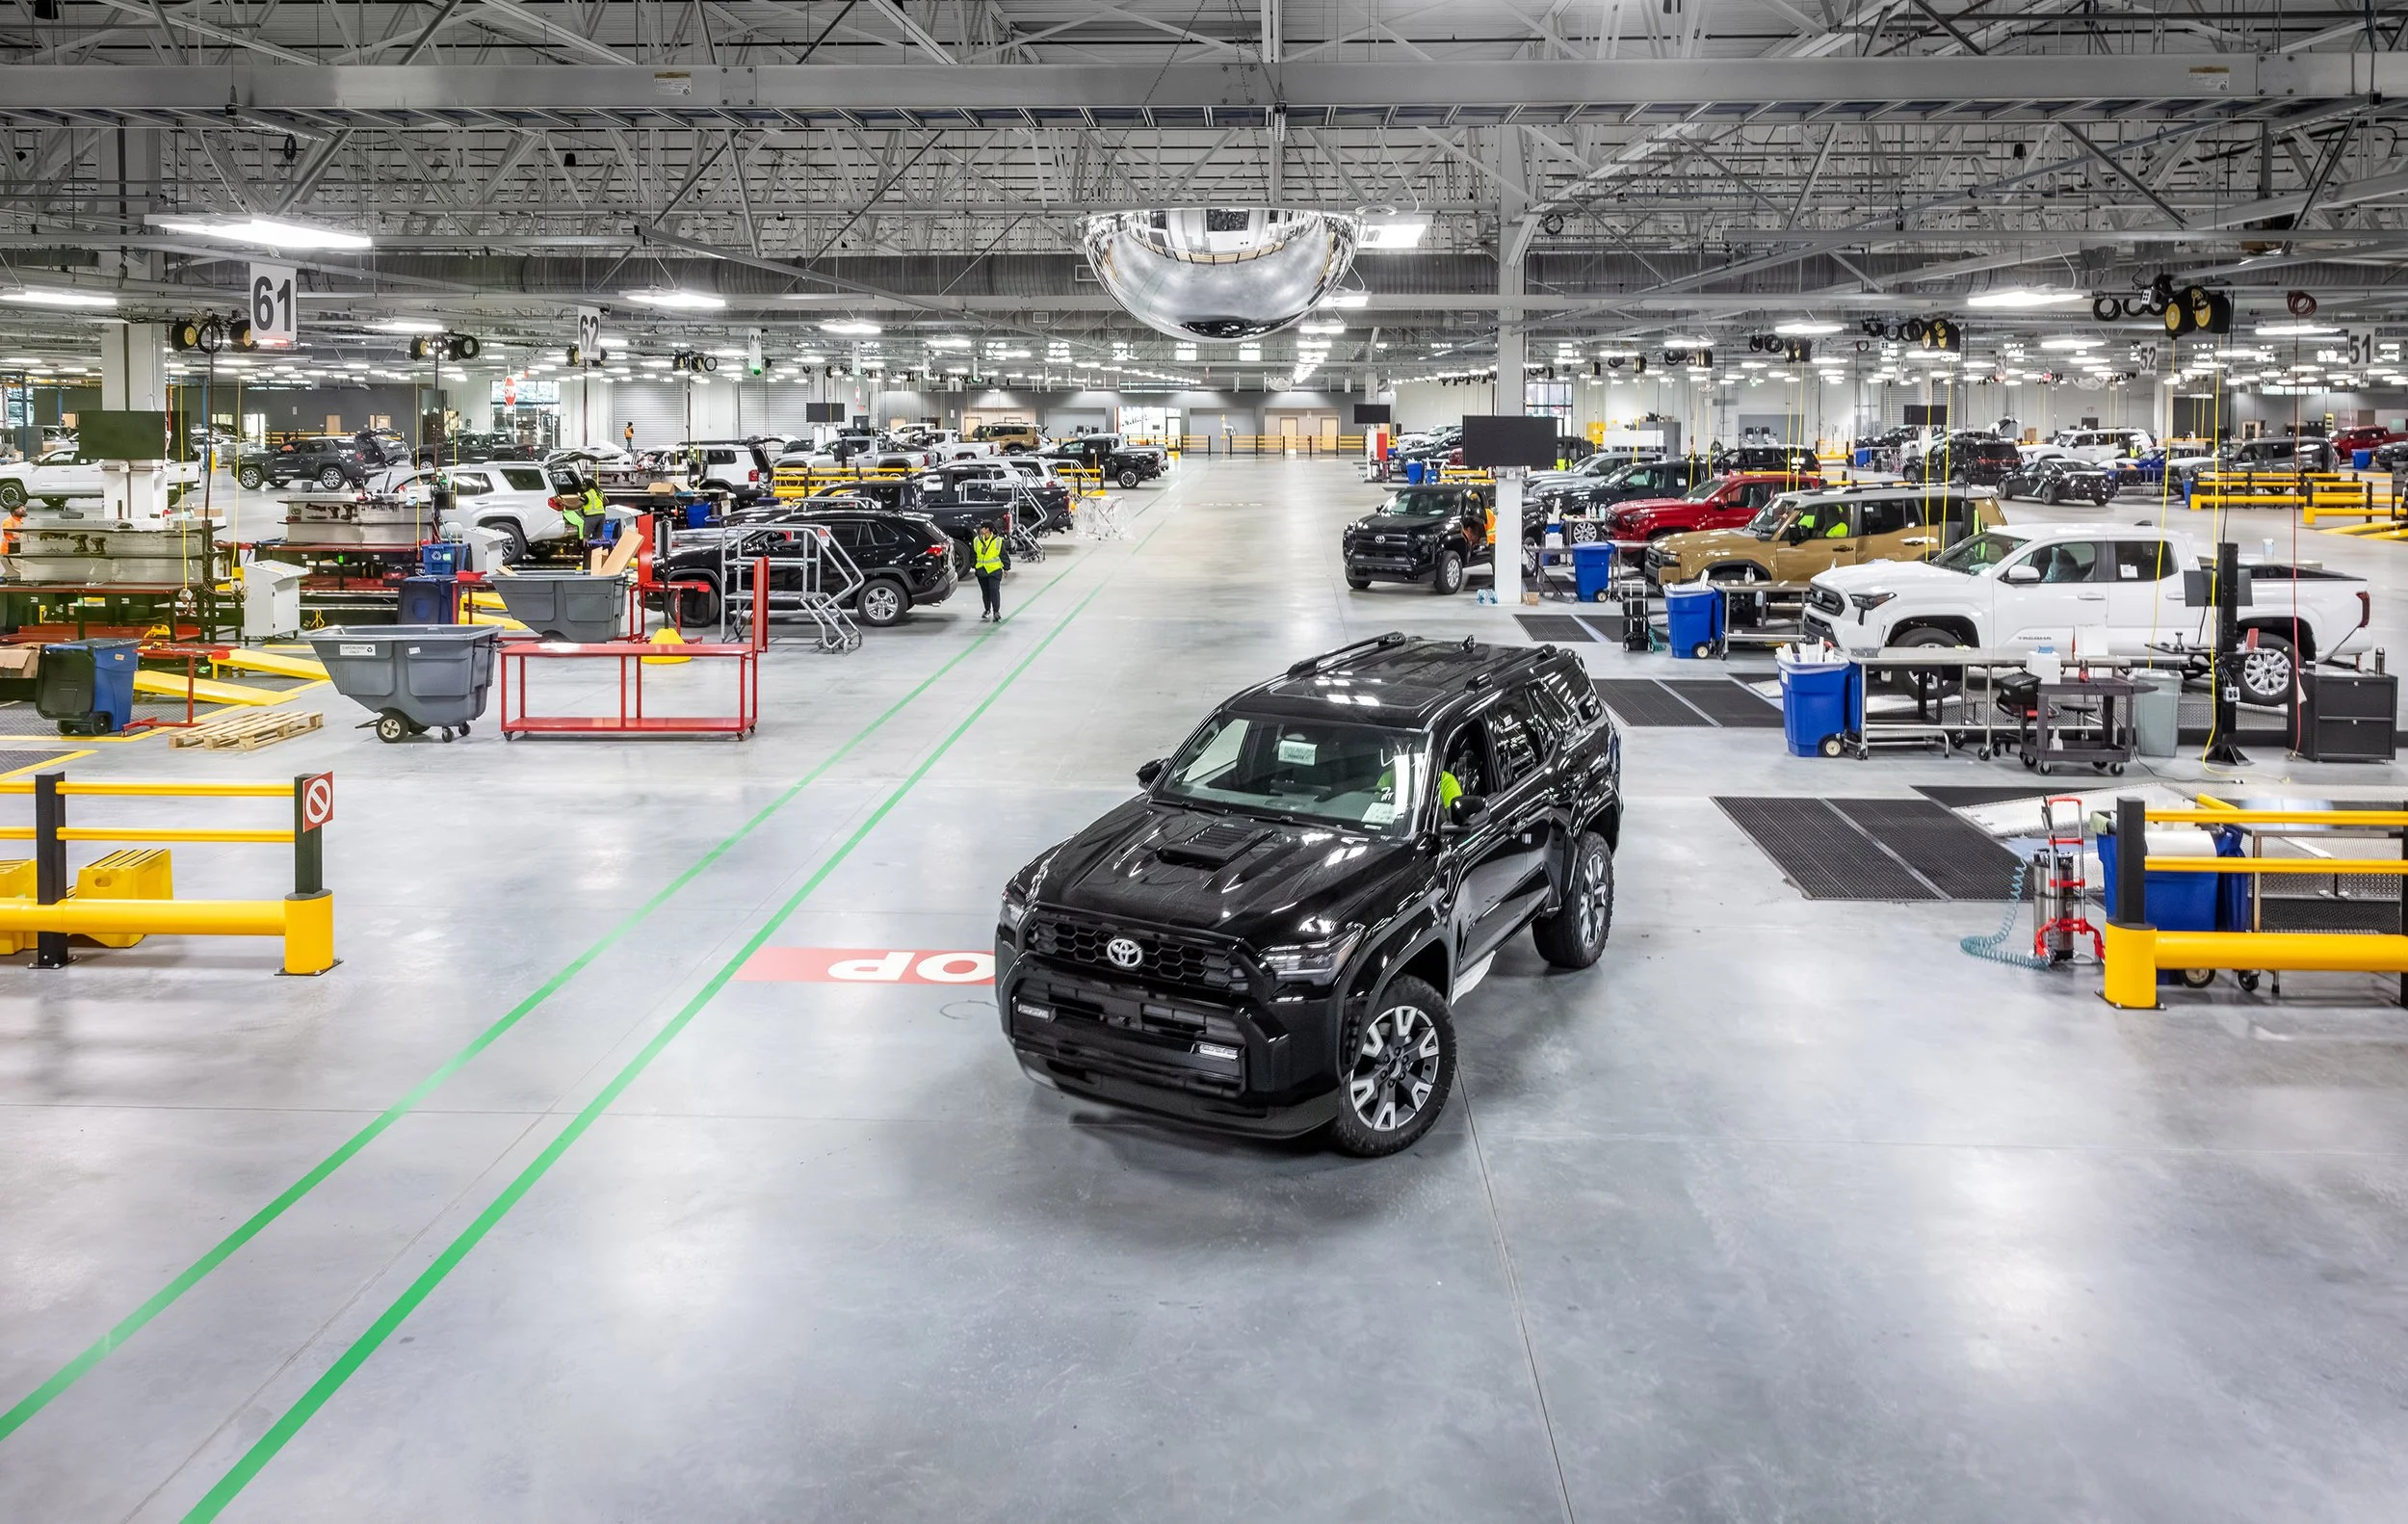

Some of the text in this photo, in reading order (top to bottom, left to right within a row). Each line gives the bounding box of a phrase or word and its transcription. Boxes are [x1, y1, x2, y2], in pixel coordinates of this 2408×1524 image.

[253, 276, 291, 332] 61
[580, 315, 599, 353] 62
[2349, 333, 2370, 364] 51
[2140, 347, 2157, 370] 52
[827, 952, 996, 983] OP
